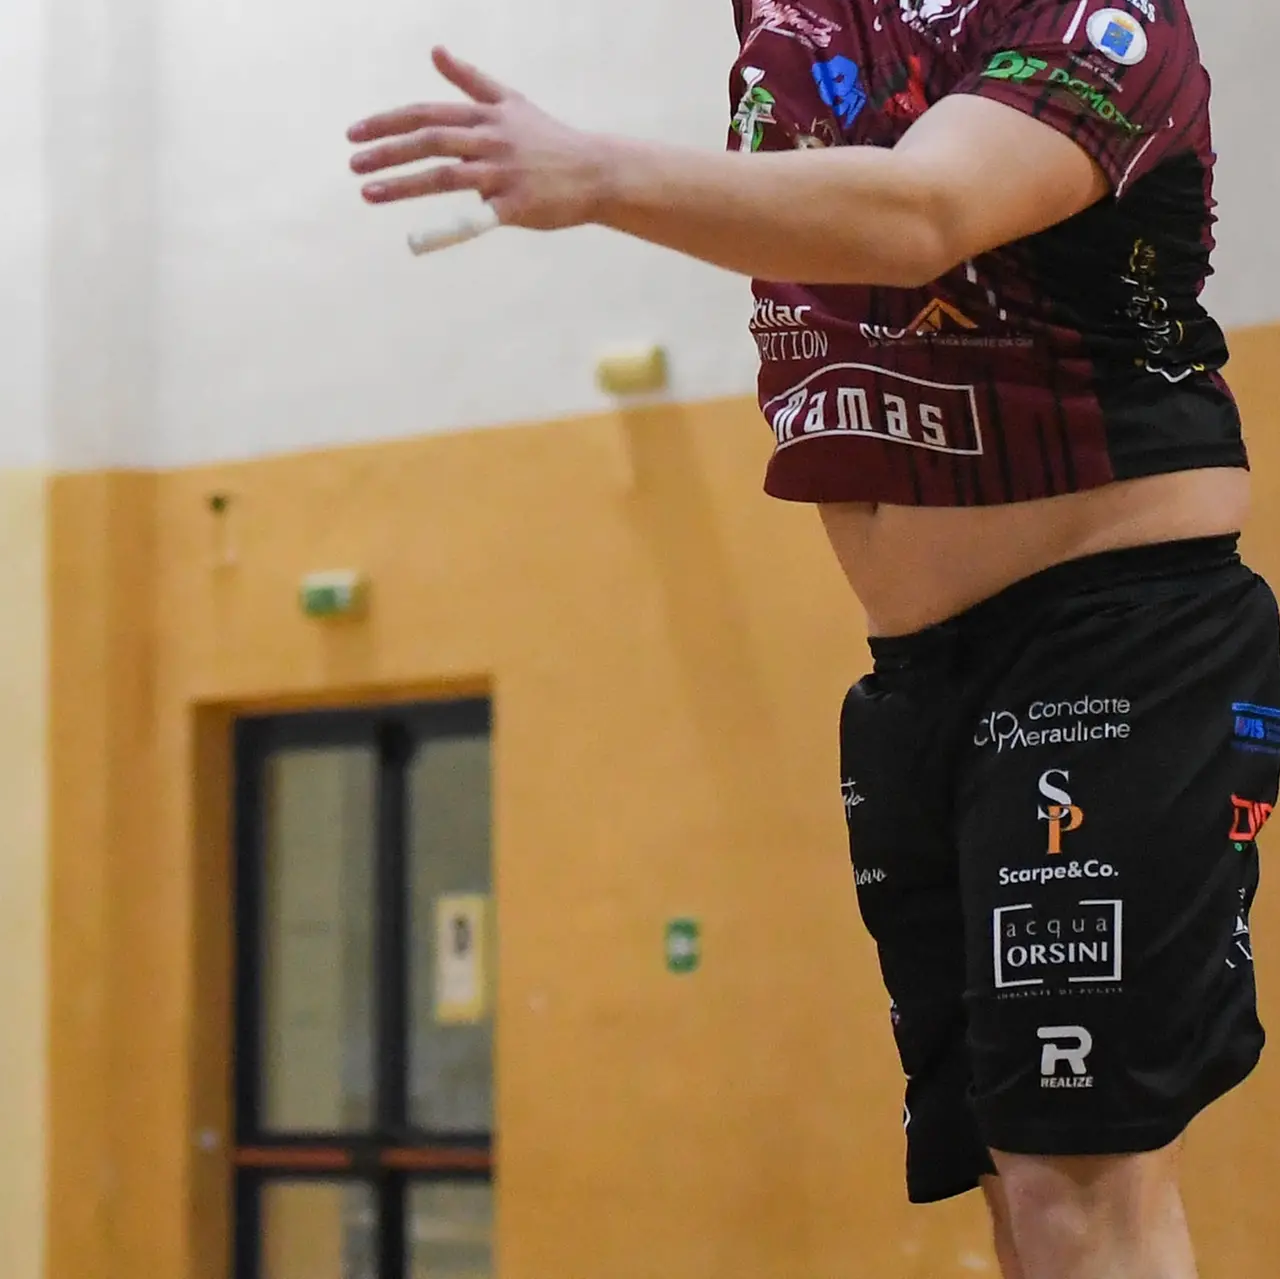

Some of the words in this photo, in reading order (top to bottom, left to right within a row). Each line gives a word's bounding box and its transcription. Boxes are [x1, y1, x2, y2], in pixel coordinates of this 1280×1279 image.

[1028, 694, 1131, 721] Condotte
[998, 859, 1120, 886] Scarpe&Co.
[1006, 917, 1109, 939] acqua
[1006, 941, 1109, 967] ORSINI
[1036, 1025, 1093, 1076] R
[1040, 1075, 1095, 1089] REALIZE
